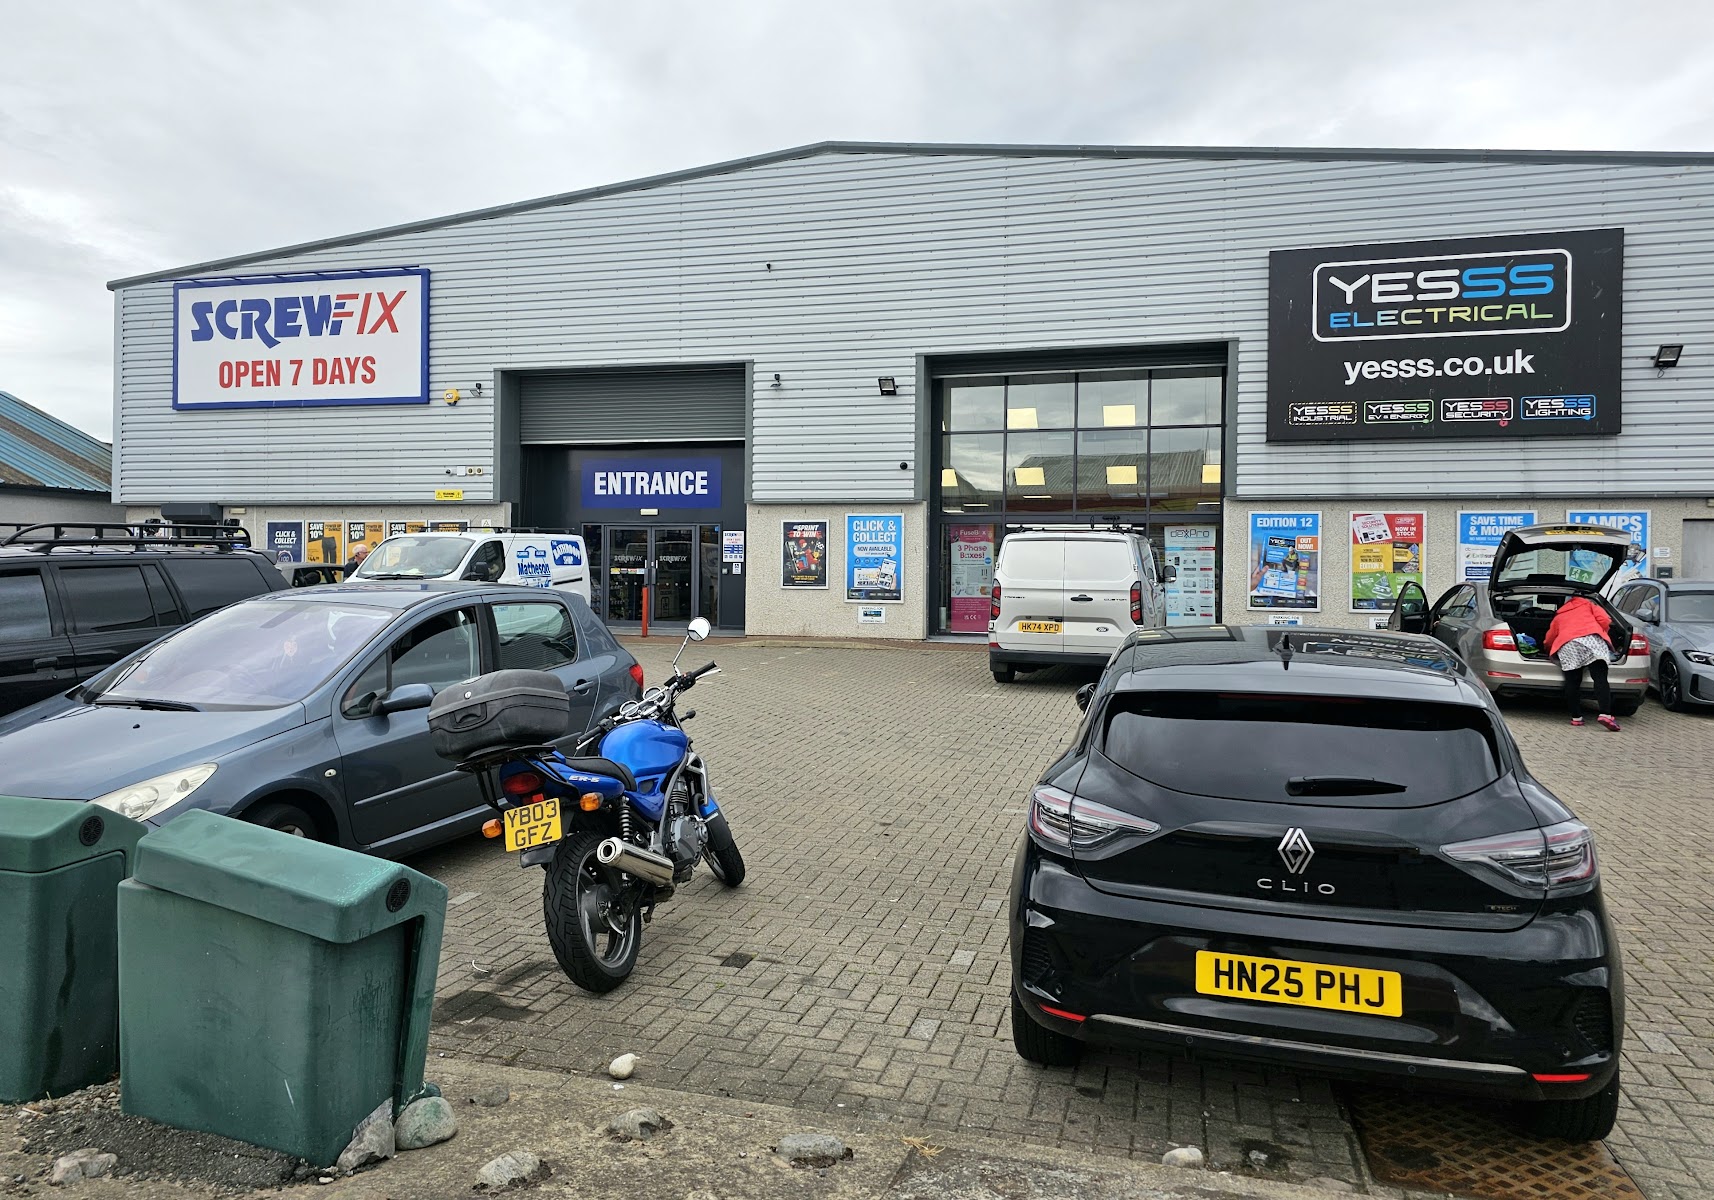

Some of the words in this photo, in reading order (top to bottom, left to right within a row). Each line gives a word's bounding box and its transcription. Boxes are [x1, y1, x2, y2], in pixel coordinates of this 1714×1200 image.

[1328, 263, 1554, 305] YESSS
[190, 290, 408, 349] SCREWFIX
[1329, 303, 1554, 329] ELECTRICAL
[219, 359, 281, 389] OPEN
[289, 359, 303, 386] 7
[312, 355, 376, 386] DAYS
[1344, 348, 1536, 385] yesss.co.uk
[1367, 403, 1430, 414] YESSS
[1445, 400, 1509, 412] YESSS
[1525, 398, 1591, 409] YESSS
[1293, 405, 1353, 415] YESSS
[1445, 411, 1509, 419] SECURITY
[1525, 407, 1591, 417] LIGHTING
[1293, 414, 1353, 422] INDUSTRIAL
[594, 470, 708, 495] ENTRANCE
[853, 520, 884, 531] CLICK
[888, 520, 896, 531] &
[1256, 517, 1297, 528] EDITION
[1300, 517, 1313, 528] 12
[1470, 515, 1497, 526] SAVE
[1497, 515, 1524, 526] TIME
[350, 523, 364, 531] SAVE
[391, 523, 405, 531] SAVE
[1468, 525, 1478, 536] &
[1480, 525, 1522, 536] MON
[275, 530, 290, 538] CLICK
[291, 530, 296, 538] &
[309, 530, 323, 539] 10%
[350, 531, 364, 540] 10%
[853, 531, 897, 543] COLLECT
[274, 537, 297, 545] COLLECT
[957, 544, 963, 552] 3
[963, 544, 987, 552] Phase
[614, 555, 643, 563] SCREWFIX
[659, 555, 688, 564] SCREWFIX
[1021, 622, 1042, 631] HK74
[1043, 623, 1060, 632] XPD
[568, 774, 601, 783] ER-5
[506, 800, 557, 828] YB03
[514, 821, 553, 848] GFZ
[1256, 877, 1336, 896] CLIO
[1214, 957, 1304, 998] HN25
[1315, 969, 1385, 1008] PHJ
